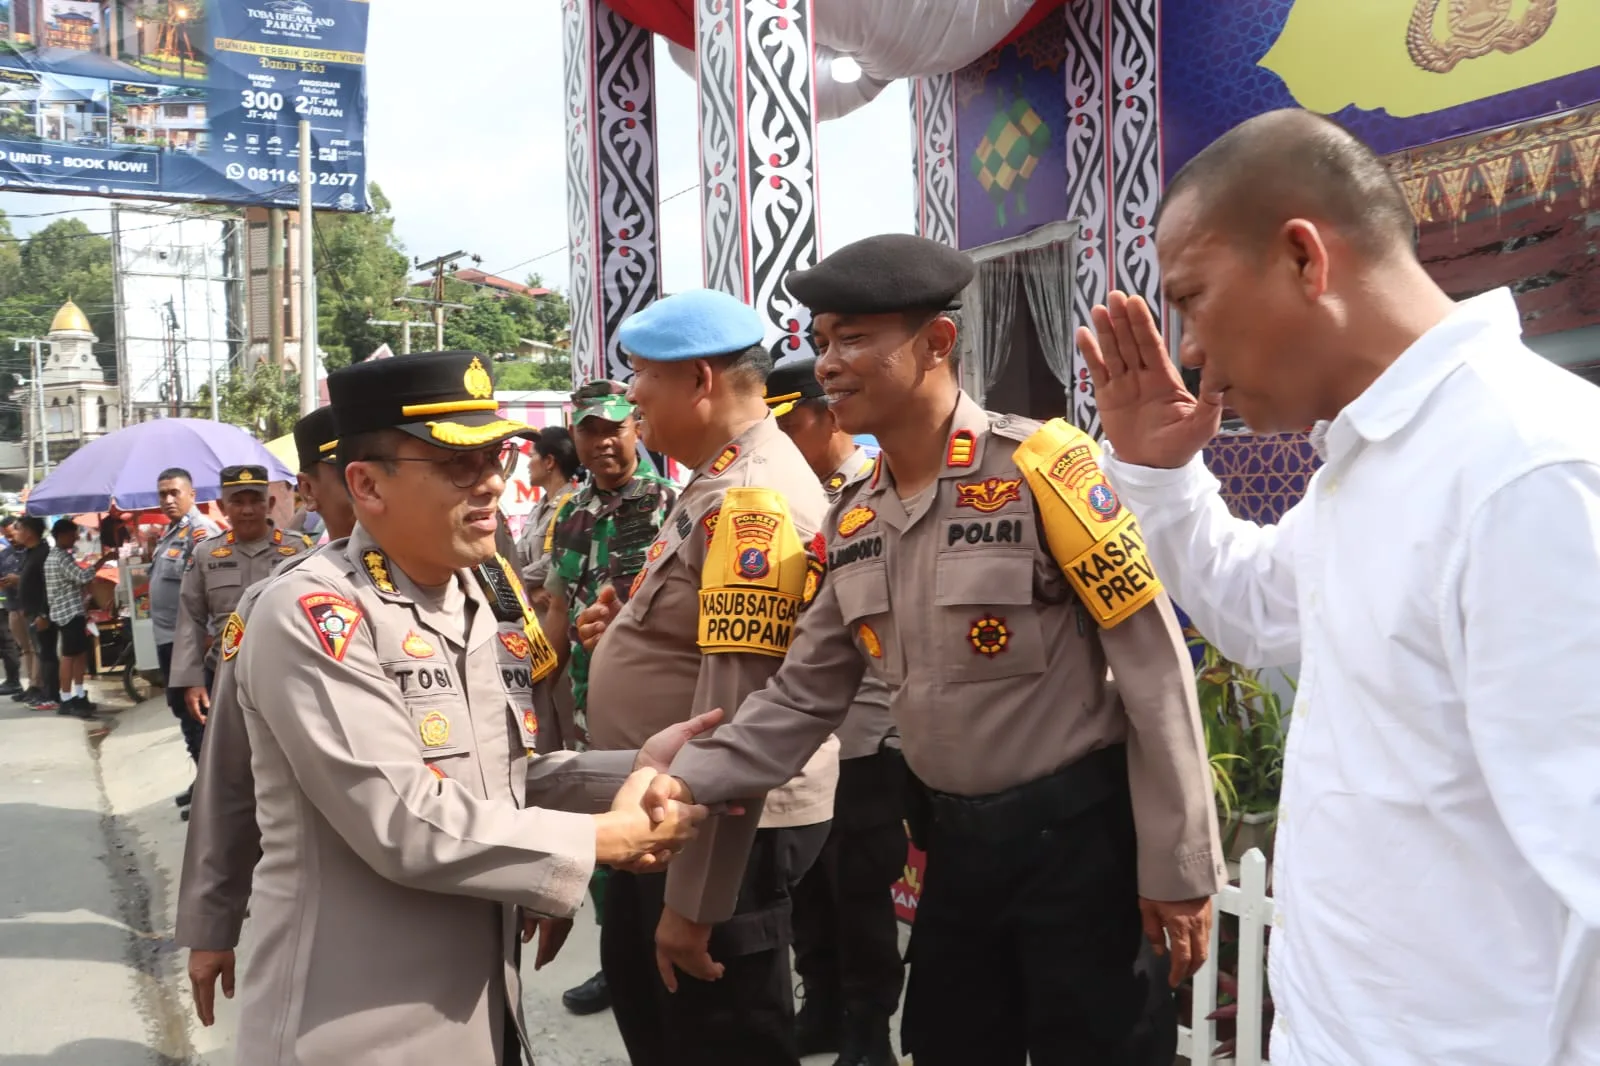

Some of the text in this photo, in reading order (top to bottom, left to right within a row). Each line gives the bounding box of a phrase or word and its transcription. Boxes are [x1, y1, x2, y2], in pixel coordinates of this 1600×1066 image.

[247, 9, 335, 27] TOBA DREAMLAND
[266, 20, 317, 33] PARAPAT
[259, 46, 301, 57] TERBAIK
[303, 50, 337, 60] DIRECT
[339, 54, 363, 63] VIEW
[241, 89, 284, 111] 300
[295, 96, 309, 113] 2
[246, 110, 277, 120] JT-AN
[9, 151, 52, 165] UNITS
[63, 157, 105, 171] BOOK
[107, 161, 148, 173] NOW!
[248, 167, 358, 186] 0811 60 2677
[948, 520, 1023, 547] POLRI
[707, 618, 791, 648] PROPAM
